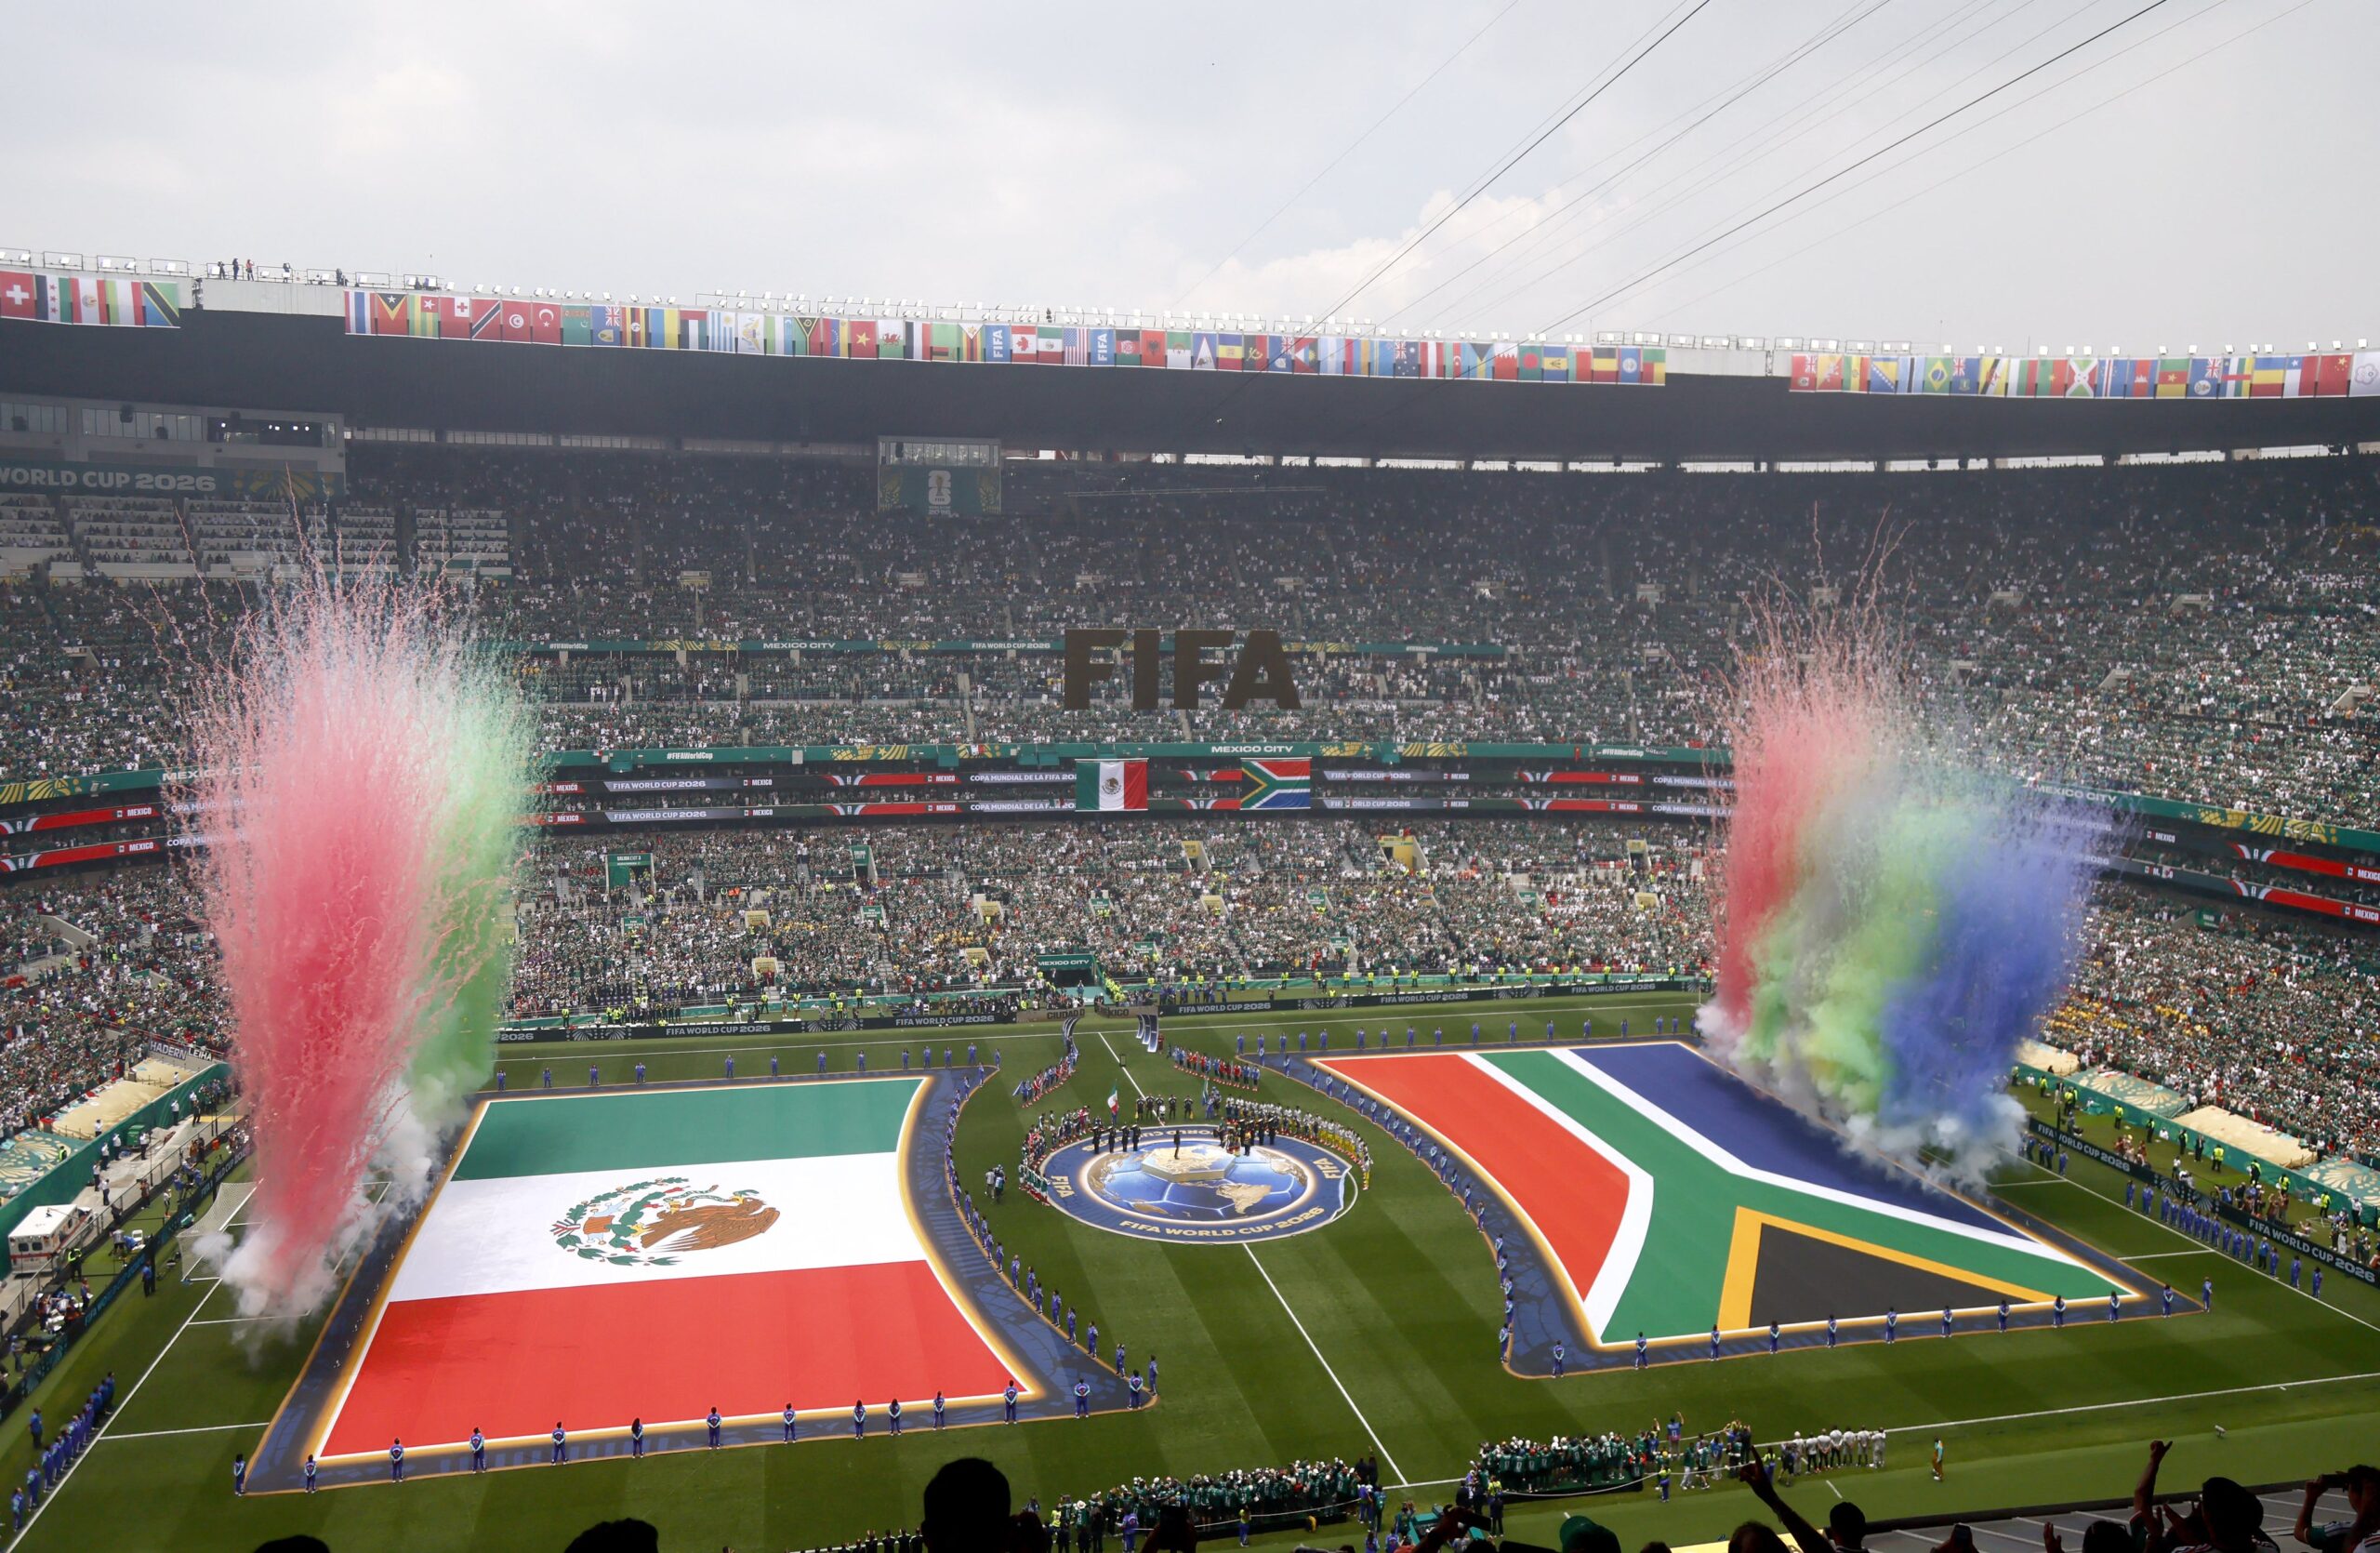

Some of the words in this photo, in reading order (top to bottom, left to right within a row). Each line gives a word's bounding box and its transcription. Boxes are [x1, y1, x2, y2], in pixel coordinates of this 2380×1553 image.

[993, 329, 1003, 358] FIFA
[1097, 333, 1107, 362] FIFA
[82, 471, 130, 488] CUP
[135, 472, 217, 492] 2026
[1064, 628, 1302, 710] FIFA
[1211, 745, 1263, 753] MEXICO
[1263, 745, 1294, 753] CITY
[667, 751, 713, 761] #FIFAWorldCup
[752, 778, 773, 787] MEXICO
[1620, 775, 1639, 783] MEXICO
[2086, 792, 2118, 804] CITY
[126, 806, 152, 817] MEXICO
[1673, 806, 1705, 815] MUNDIAL
[2087, 819, 2112, 831] 2026
[2155, 832, 2175, 843] MEXICO
[128, 842, 154, 853] MEXICO
[2354, 908, 2380, 922] MEXICO
[1572, 986, 1588, 994] FIFA
[1589, 986, 1614, 994] WORLD
[1631, 983, 1656, 991] 2026
[1442, 992, 1468, 1001] 2026
[1179, 1005, 1196, 1014] FIFA
[1197, 1004, 1226, 1013] WORLD
[1227, 1003, 1243, 1012] CUP
[1244, 1002, 1271, 1010] 2026
[895, 1018, 914, 1027] FIFA
[915, 1016, 945, 1026] WORLD
[965, 1015, 995, 1023] 2026
[666, 1027, 685, 1035] FIFA
[686, 1027, 719, 1035] WORLD
[721, 1026, 738, 1034] CUP
[739, 1025, 771, 1033] 2026
[501, 1032, 535, 1041] 2026
[150, 1041, 186, 1060] HADERN
[188, 1047, 212, 1061] LEIHA
[2038, 1123, 2055, 1139] FIFA
[2083, 1145, 2100, 1159] CUP
[2100, 1152, 2131, 1173] 2026
[1313, 1157, 1343, 1179] FIFA
[1051, 1175, 1076, 1198] FIFA
[1118, 1220, 1161, 1234] FIFA
[1165, 1228, 1236, 1237] WORLD
[1238, 1224, 1274, 1235] CUP
[1275, 1207, 1325, 1228] 2026
[2249, 1217, 2270, 1237] FIFA
[2271, 1229, 2311, 1254] WORLD
[2311, 1247, 2334, 1263] CUP
[2334, 1256, 2376, 1283] 2026
